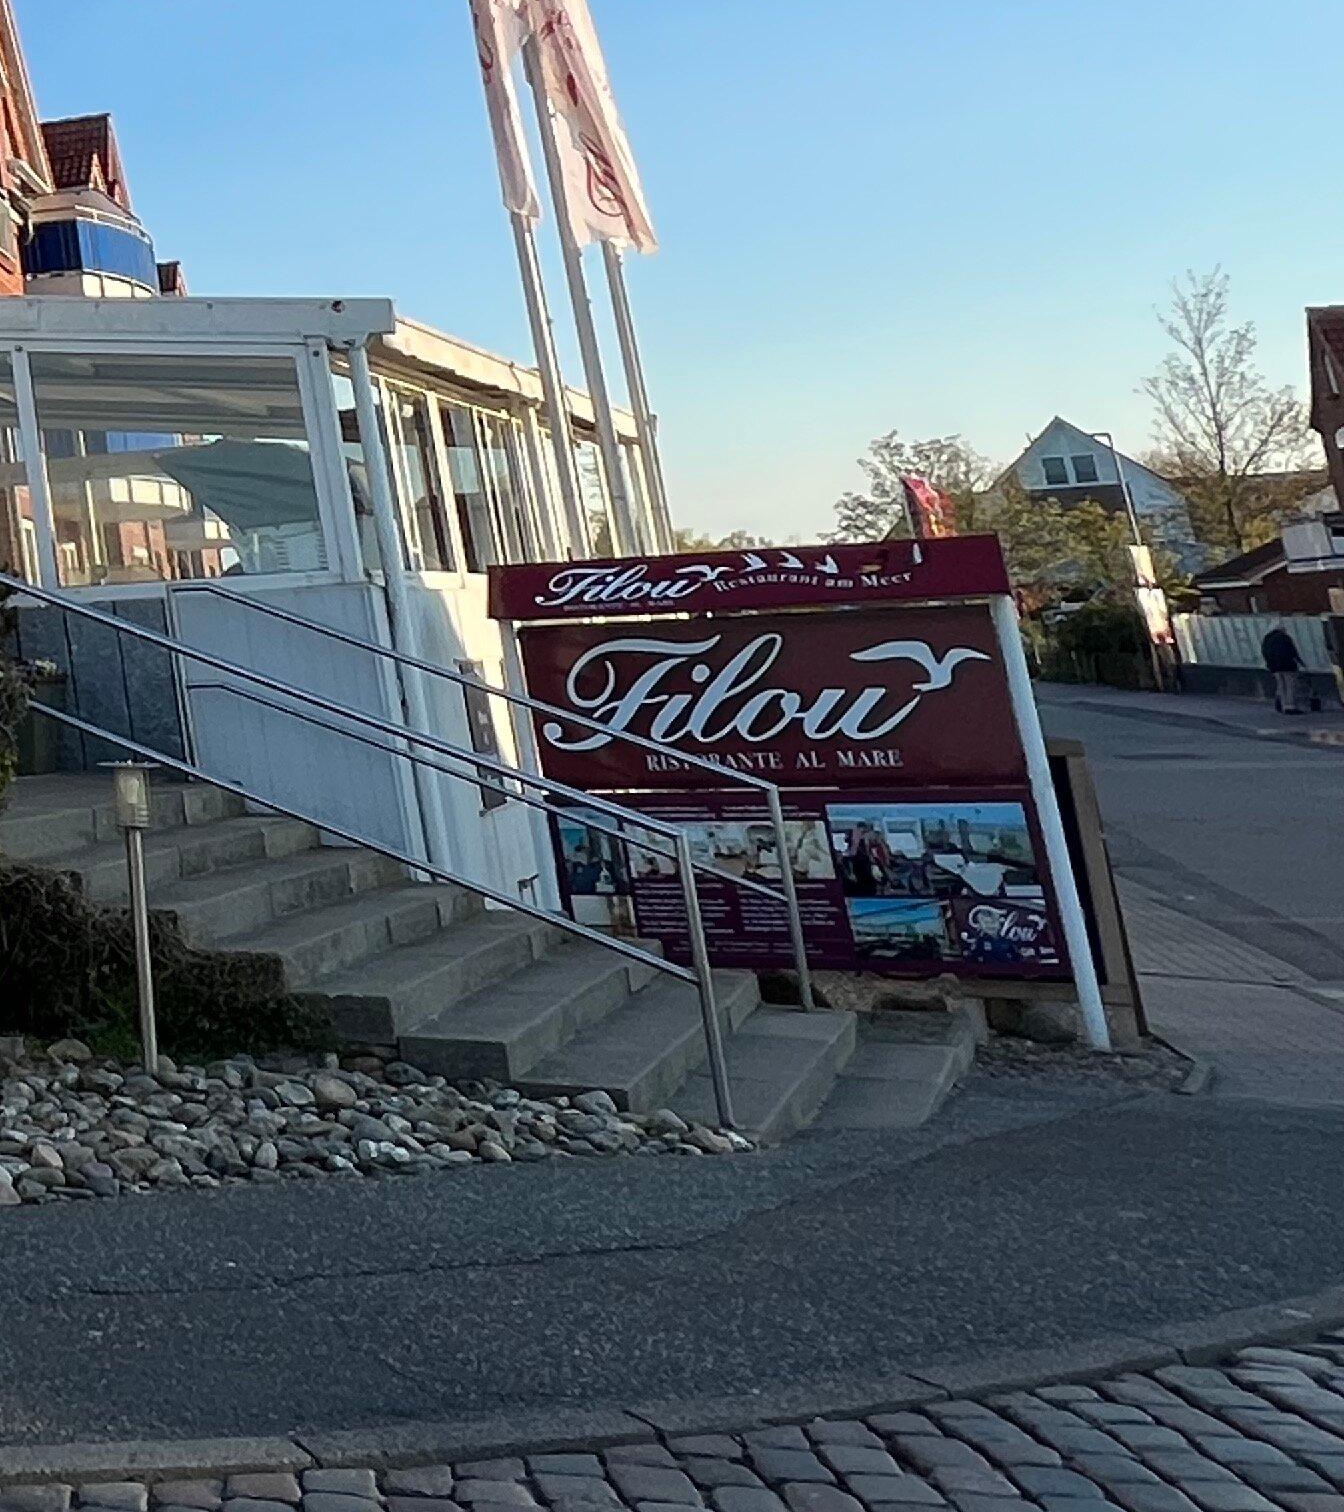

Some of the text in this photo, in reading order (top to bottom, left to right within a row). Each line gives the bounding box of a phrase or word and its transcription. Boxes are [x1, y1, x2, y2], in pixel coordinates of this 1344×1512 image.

[534, 564, 702, 606] Filou
[713, 573, 818, 592] Restaurant
[861, 571, 912, 588] Meer
[543, 633, 922, 752] Filou
[647, 748, 904, 771] RISRANTE AL MARE
